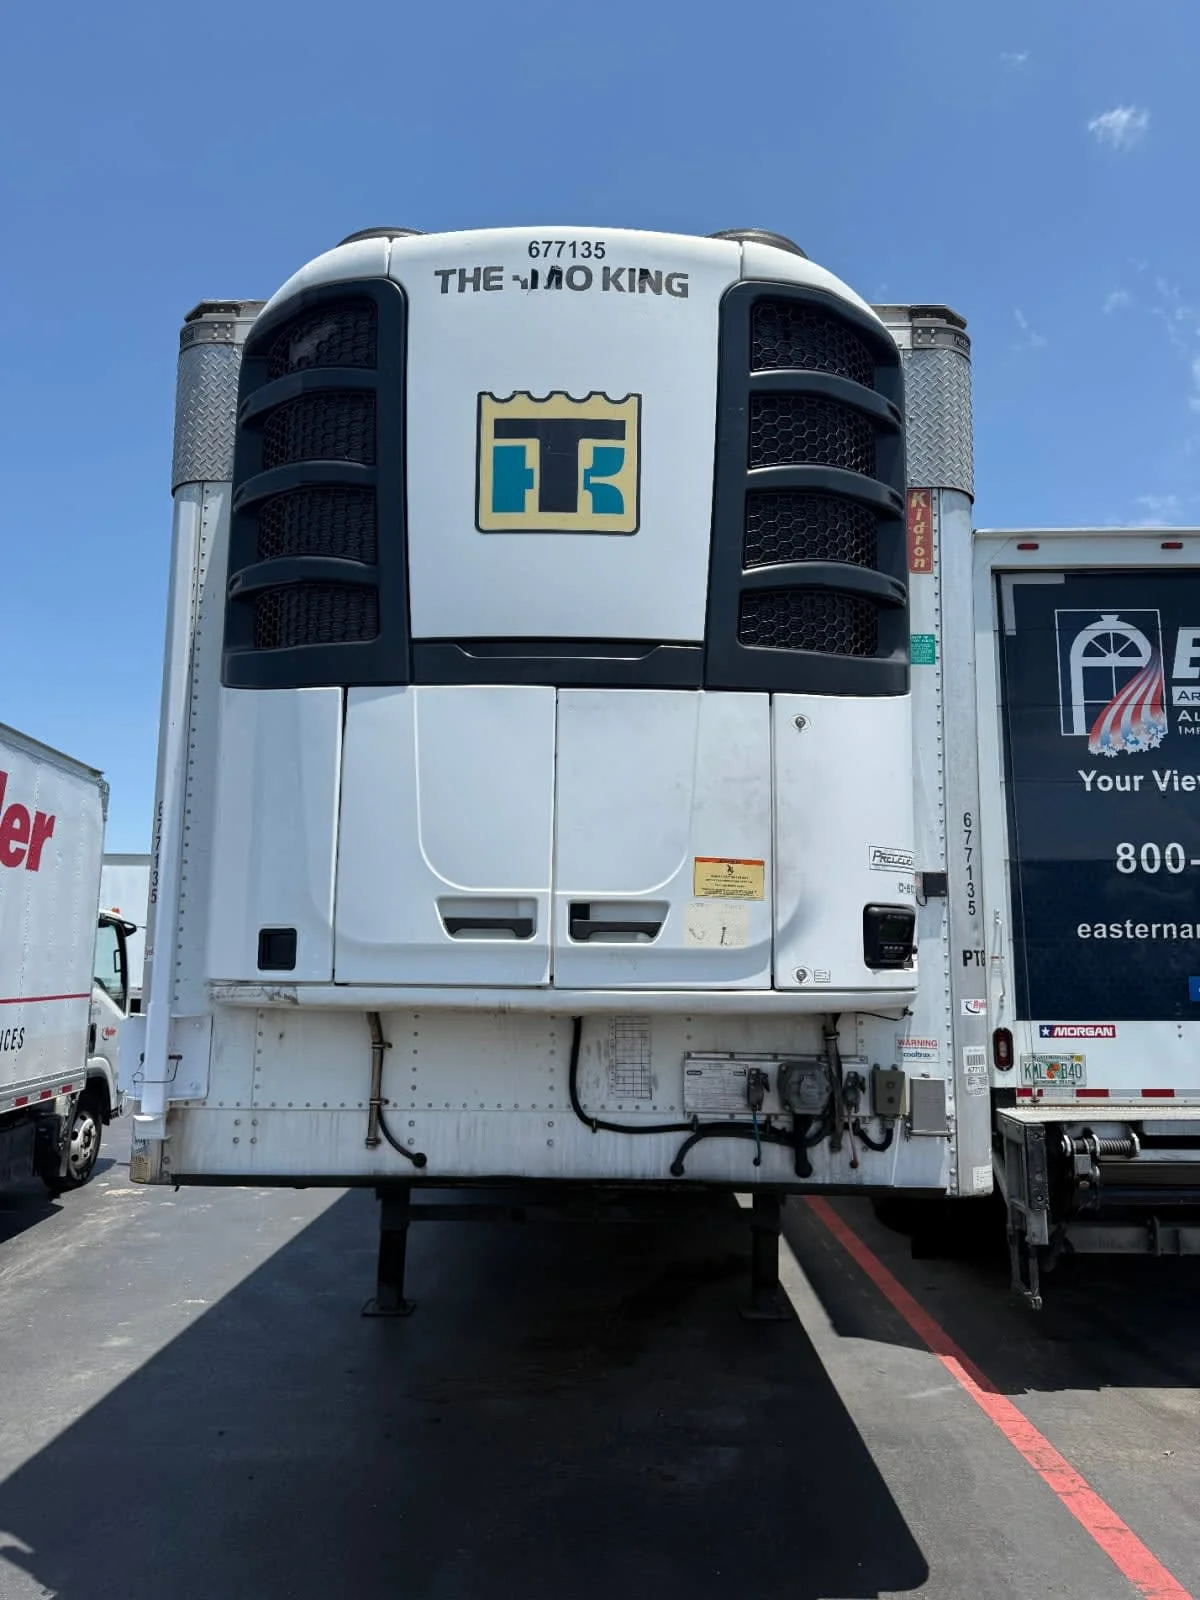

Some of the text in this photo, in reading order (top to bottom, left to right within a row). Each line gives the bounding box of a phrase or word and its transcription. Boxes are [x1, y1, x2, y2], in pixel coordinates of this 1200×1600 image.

[528, 240, 606, 259] 677135
[602, 266, 689, 299] KING
[910, 491, 927, 569] Kidron
[1078, 769, 1144, 792] Your
[963, 811, 976, 916] 677135
[1053, 1025, 1113, 1037] MORGAN
[897, 1039, 938, 1047] WARNING
